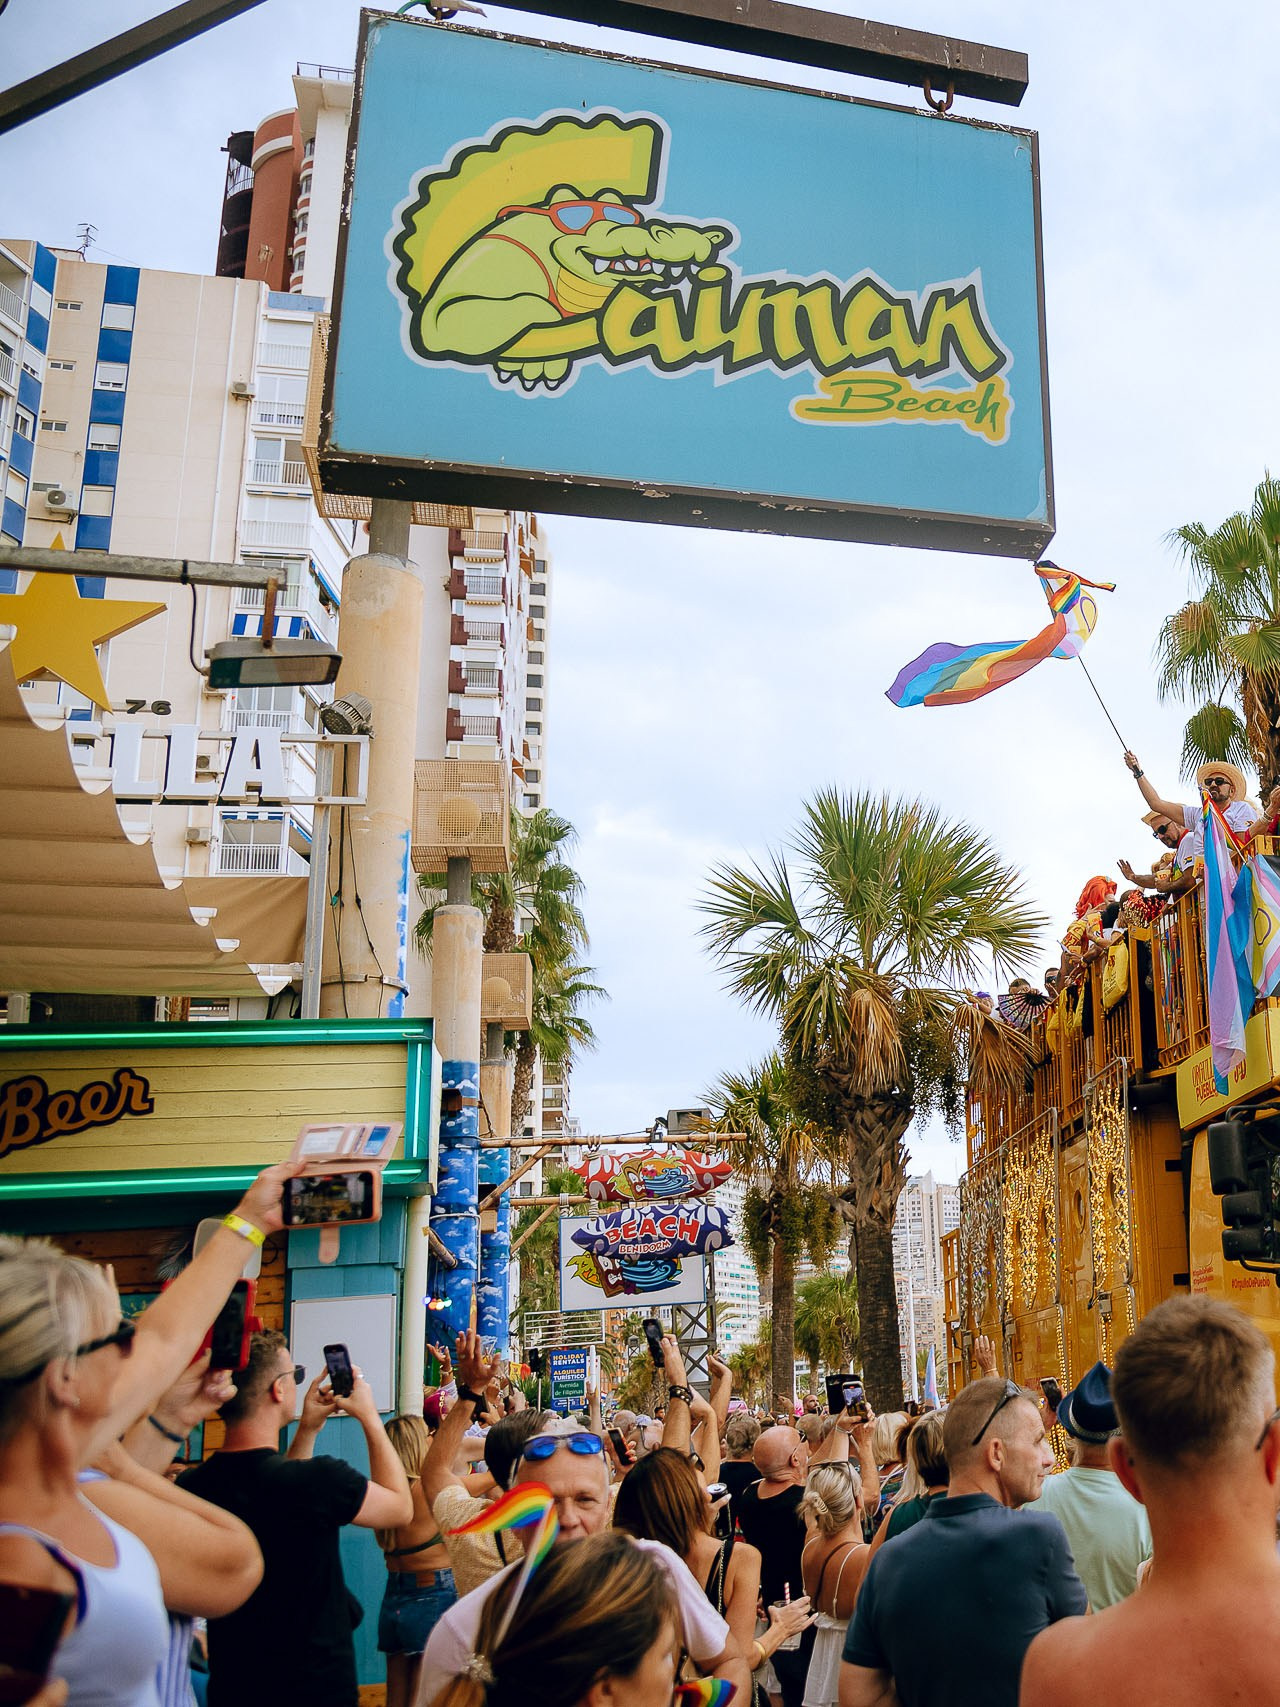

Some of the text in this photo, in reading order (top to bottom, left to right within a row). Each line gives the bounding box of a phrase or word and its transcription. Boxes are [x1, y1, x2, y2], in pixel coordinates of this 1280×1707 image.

[392, 112, 1007, 393] Caiman
[805, 378, 1001, 432] Beach
[0, 1068, 154, 1158] Beer
[604, 1215, 700, 1245] BEACH
[618, 1239, 672, 1254] BENIDORM
[552, 1353, 585, 1361] HOLIDAY
[552, 1358, 585, 1366] RENTALS
[553, 1368, 585, 1376] ALQUILER
[553, 1373, 585, 1381] TURÍSTICO
[562, 1388, 583, 1396] Filipinas
